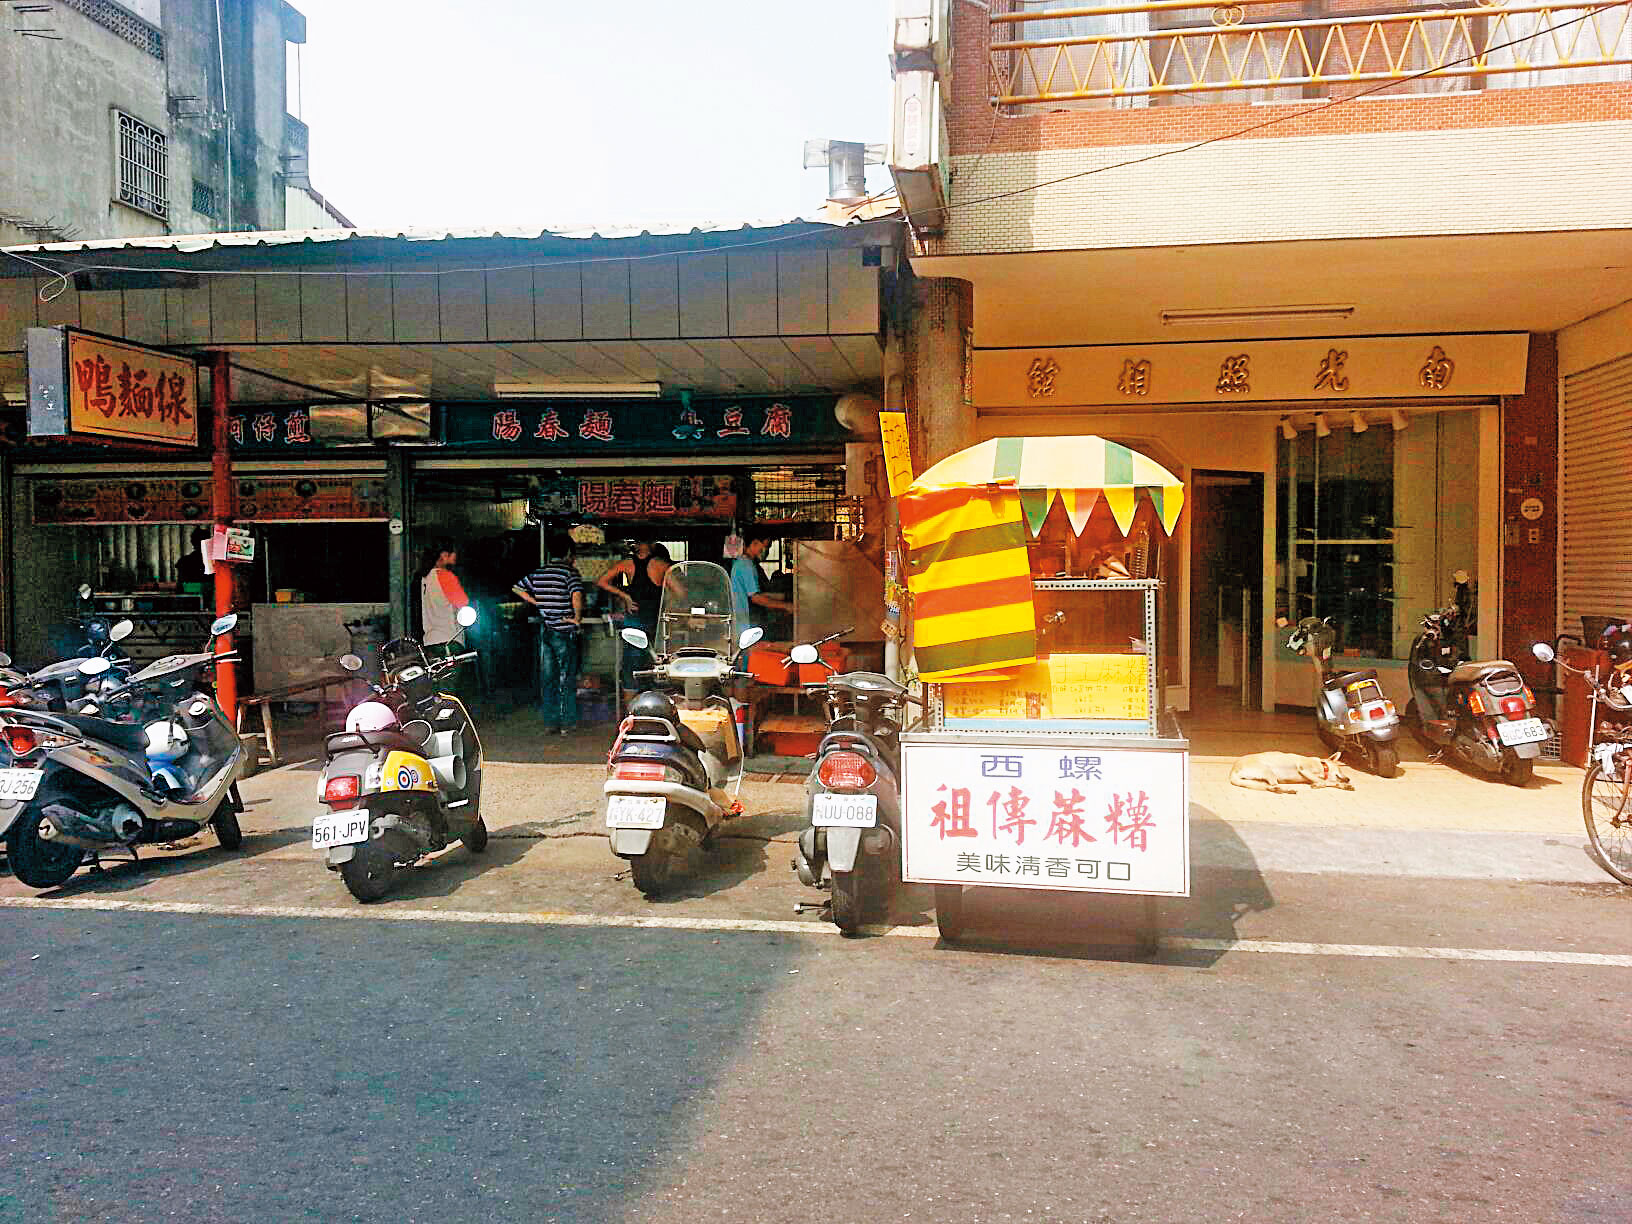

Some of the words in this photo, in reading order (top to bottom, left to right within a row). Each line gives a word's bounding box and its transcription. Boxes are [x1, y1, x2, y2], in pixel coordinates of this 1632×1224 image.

[980, 754, 1103, 781] 西螺
[313, 820, 367, 845] 561-JPV
[956, 851, 1132, 881] 美味清香可口
